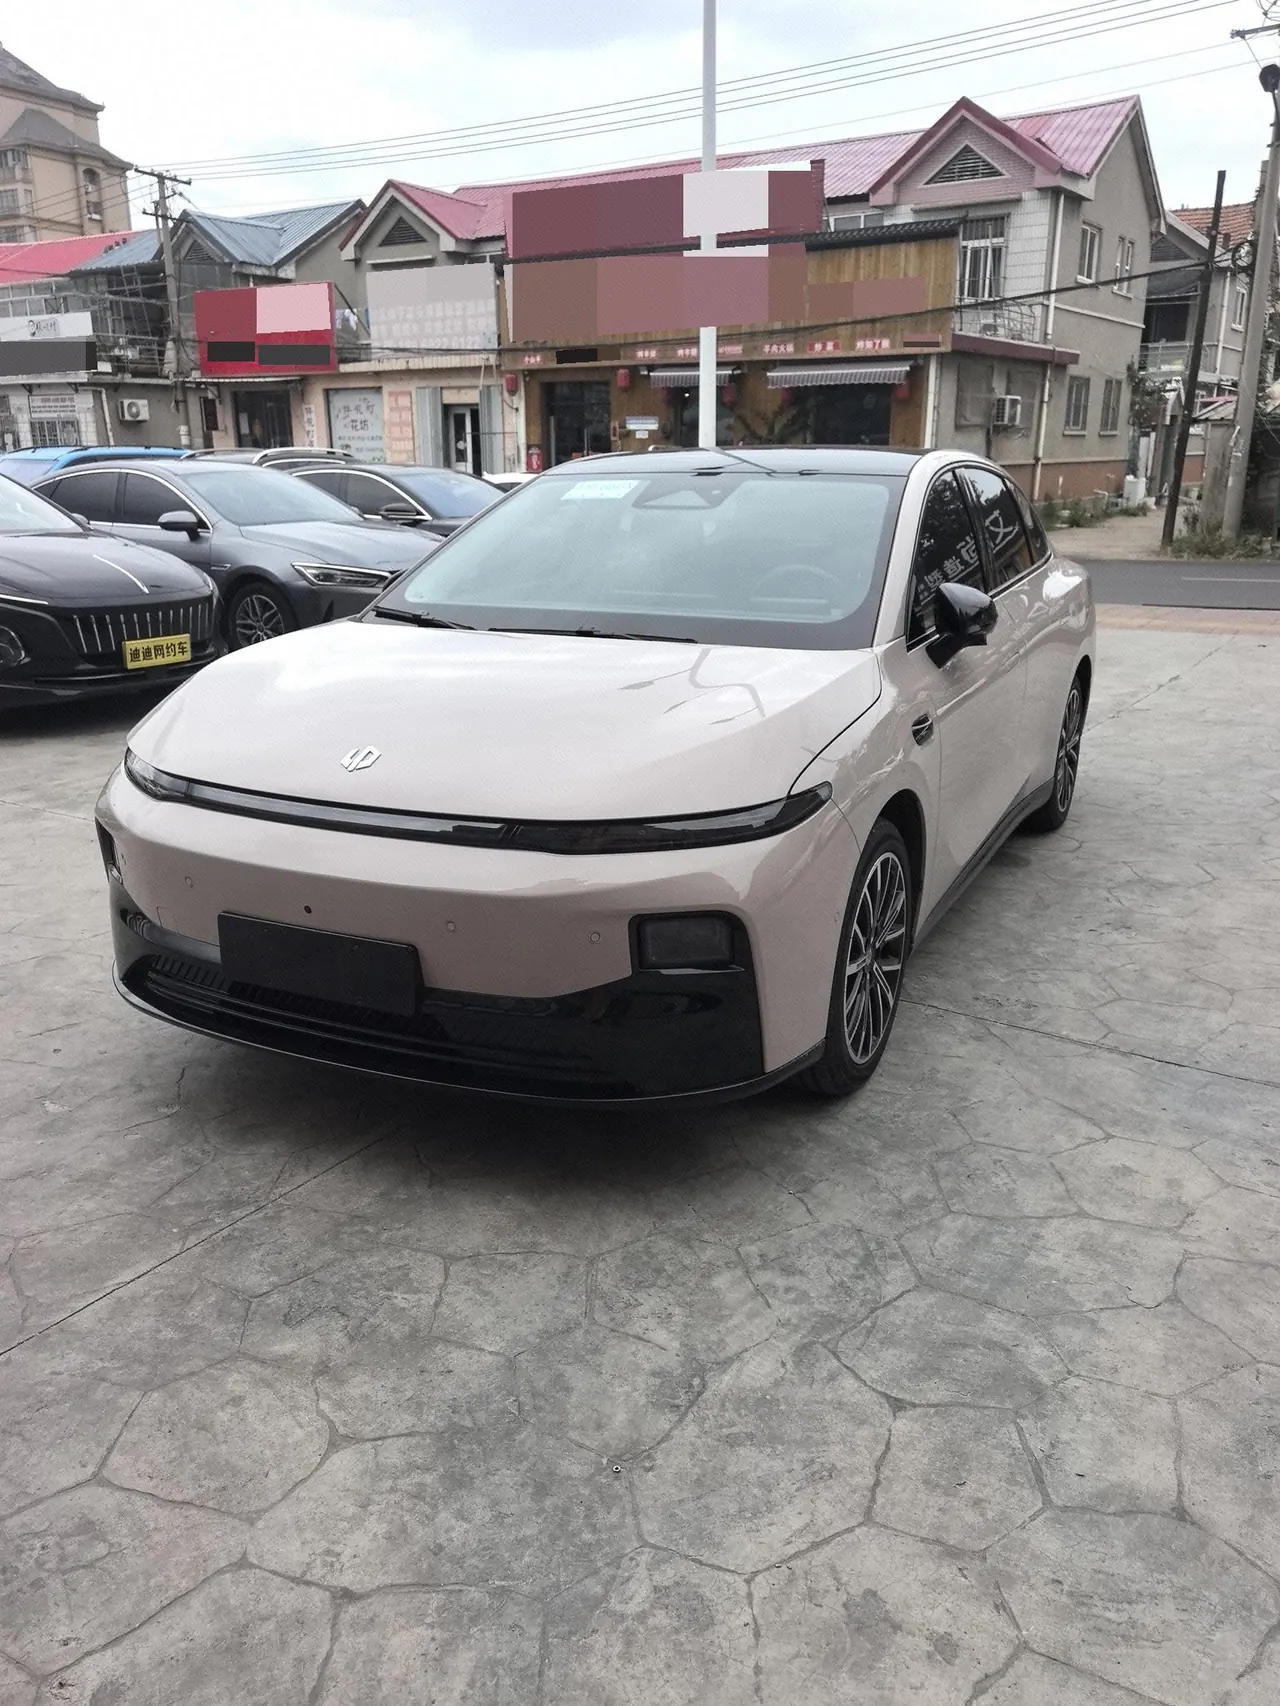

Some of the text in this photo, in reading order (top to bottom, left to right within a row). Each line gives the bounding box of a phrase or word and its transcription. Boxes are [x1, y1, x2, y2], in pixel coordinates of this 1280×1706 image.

[129, 642, 188, 663] 迪迪网约车
